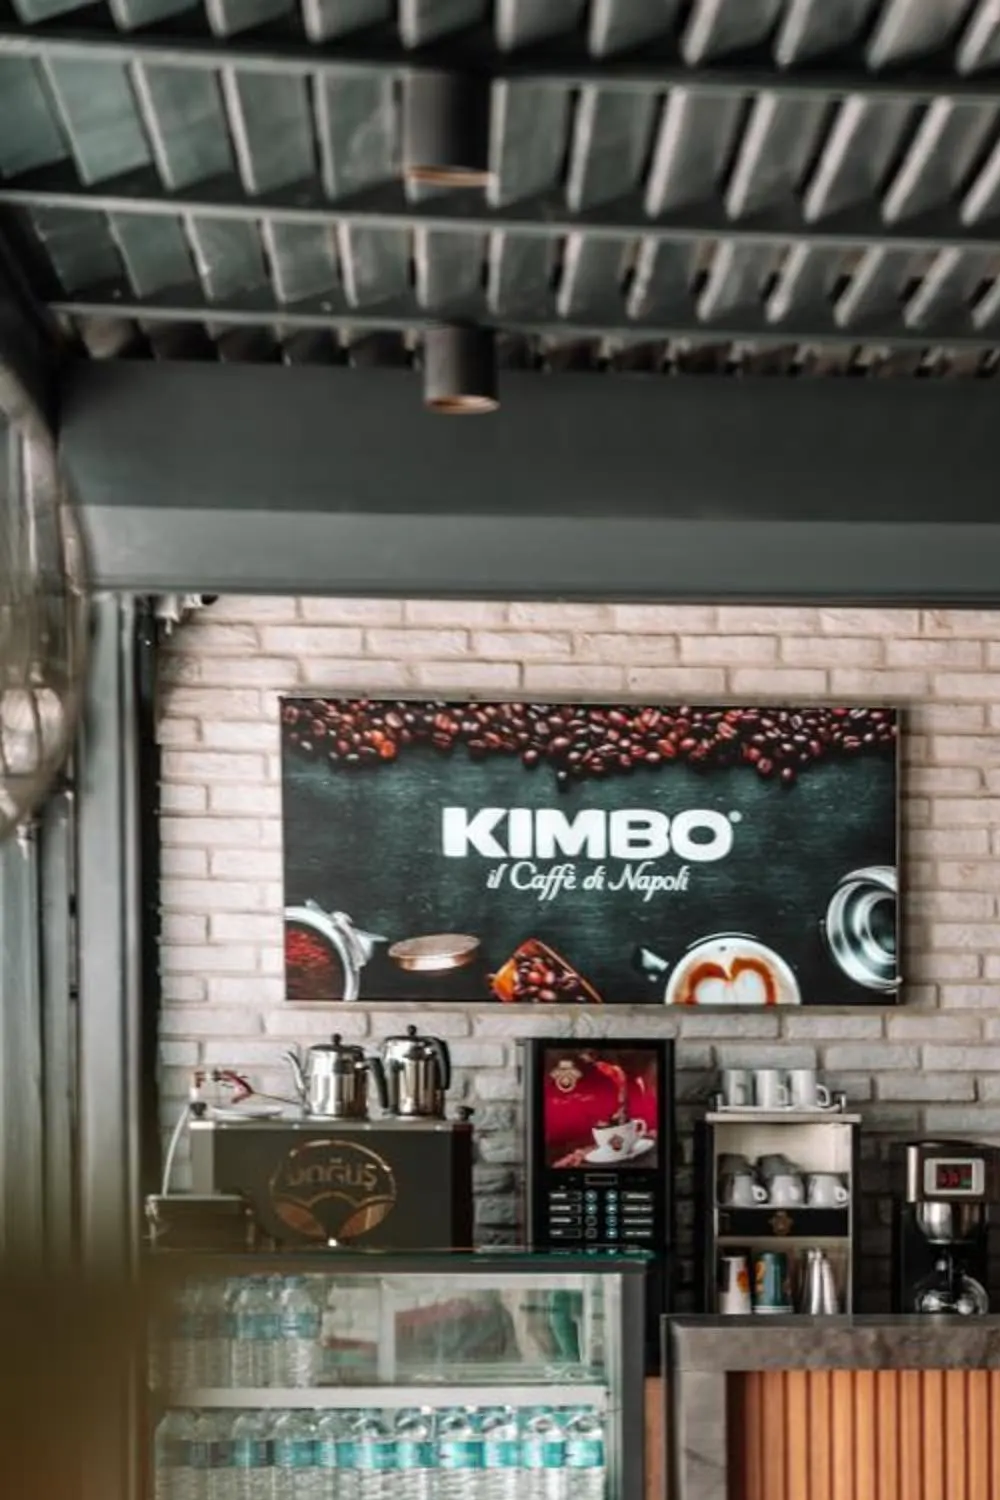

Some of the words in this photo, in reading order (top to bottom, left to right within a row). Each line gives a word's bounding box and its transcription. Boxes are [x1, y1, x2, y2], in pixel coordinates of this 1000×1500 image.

[442, 807, 734, 862] KIMBO
[486, 863, 508, 889] il
[510, 861, 577, 900] Caffè
[582, 866, 604, 889] di
[608, 862, 689, 902] Napoli
